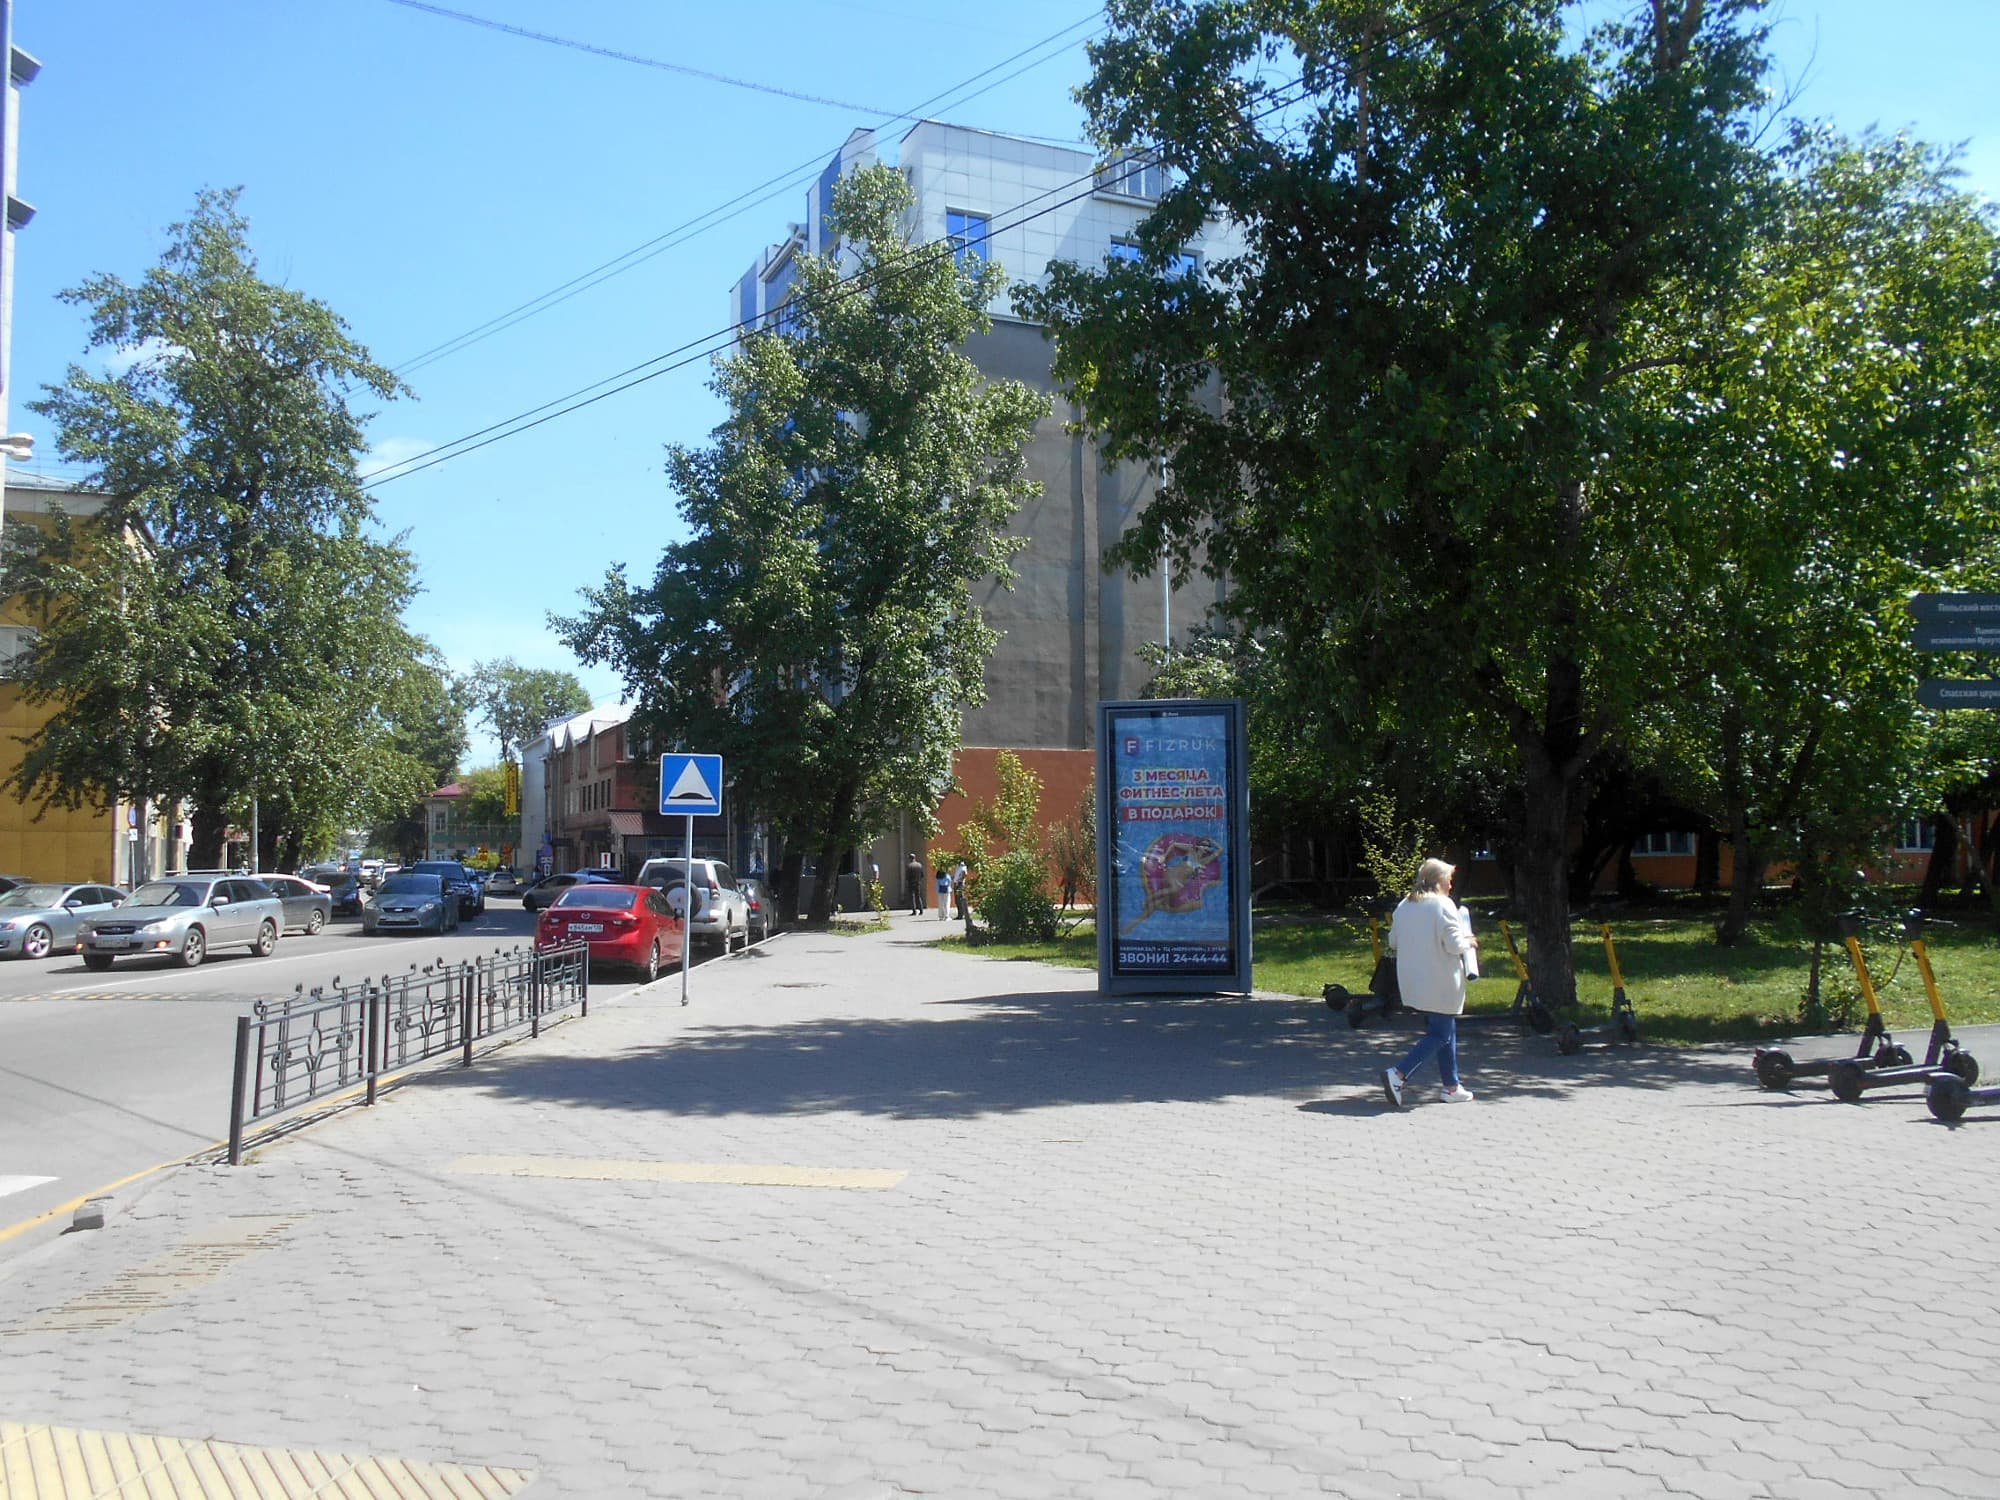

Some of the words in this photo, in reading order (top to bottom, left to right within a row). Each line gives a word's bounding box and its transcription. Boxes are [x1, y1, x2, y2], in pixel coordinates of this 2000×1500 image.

[1145, 738, 1216, 752] FIZRUK
[1134, 770, 1142, 783] 3
[1146, 769, 1208, 783] МЕСЯЦА
[1119, 786, 1224, 799] ФИТНЕС-ЛЕТА
[1128, 808, 1137, 820] В
[1141, 806, 1216, 821] ПОДАРОК
[1120, 952, 1169, 963] ЗВОНИ!
[1173, 953, 1227, 963] 24-44-44
